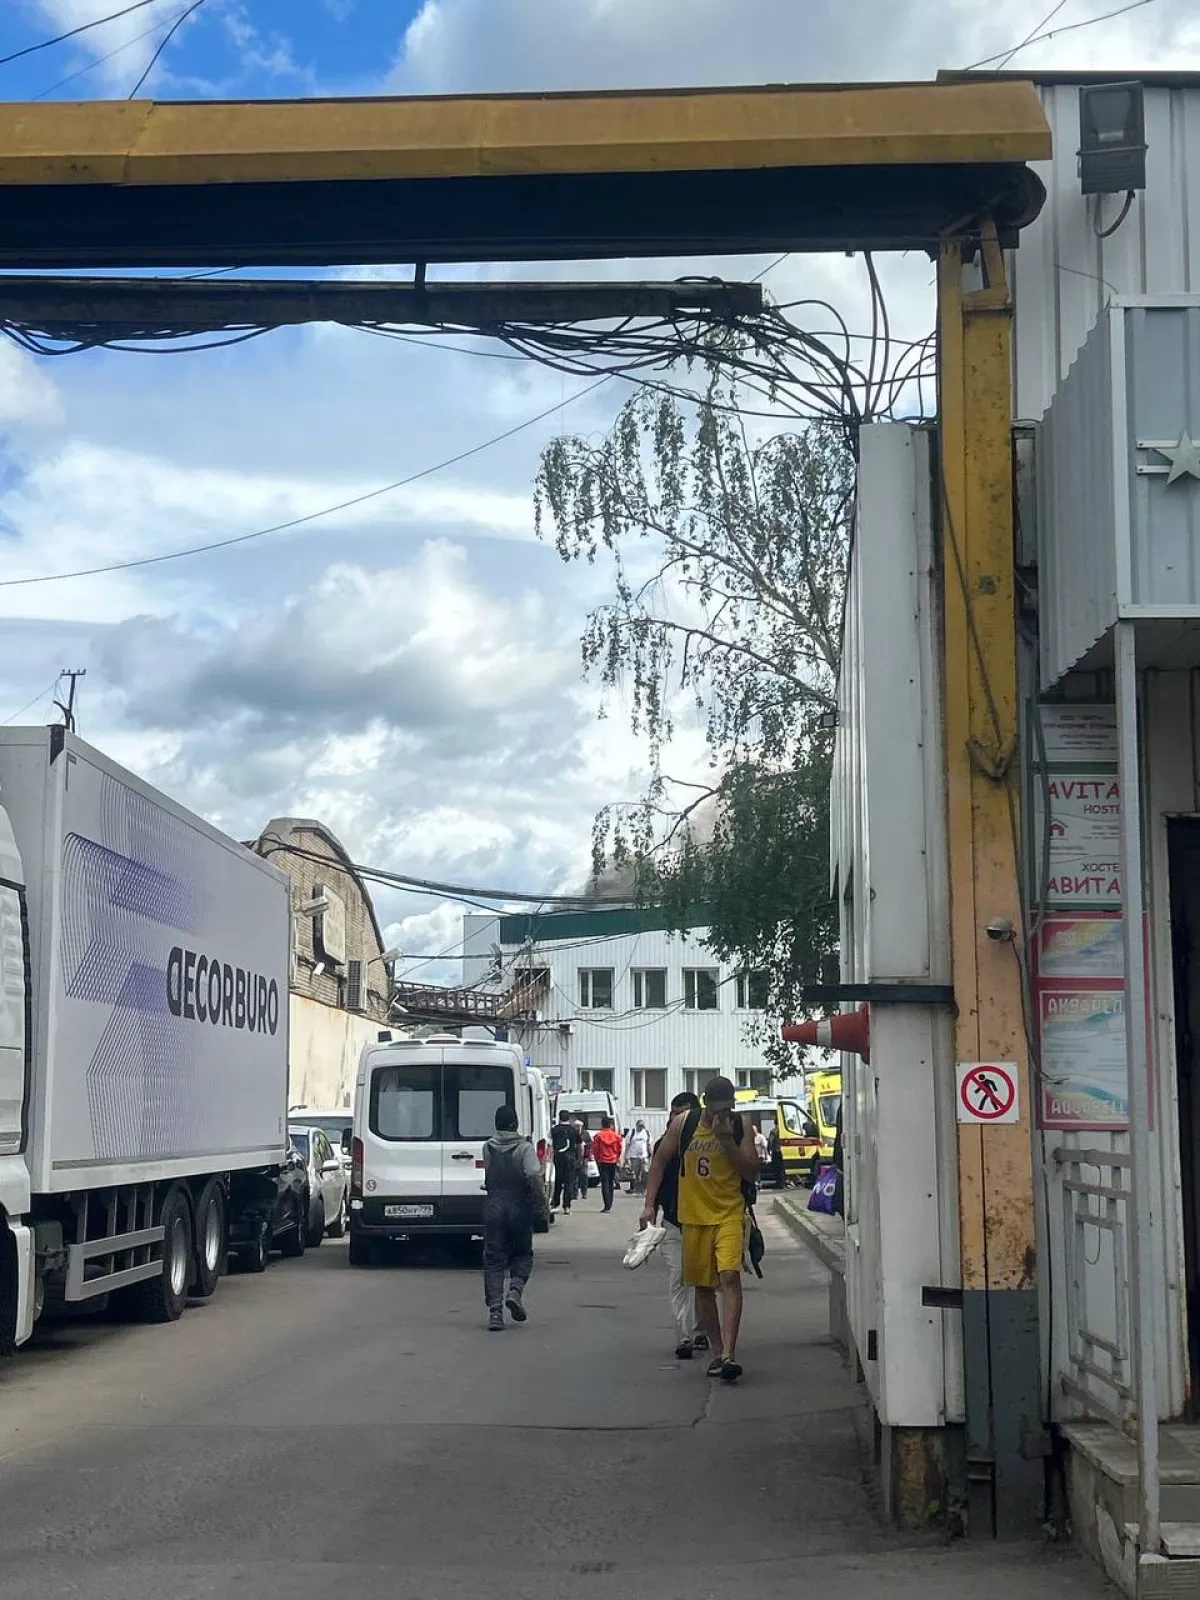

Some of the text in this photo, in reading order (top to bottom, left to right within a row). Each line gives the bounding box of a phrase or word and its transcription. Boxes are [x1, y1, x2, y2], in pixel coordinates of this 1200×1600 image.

[1048, 781, 1120, 800] AVITA
[1084, 804, 1120, 815] HOSTE
[1081, 862, 1120, 872] ХОСТЕ
[1046, 876, 1120, 895] АВИТА
[166, 946, 279, 1036] DECORBURO
[1048, 997, 1122, 1014] АКВАРЕЛ
[697, 1154, 710, 1177] 6
